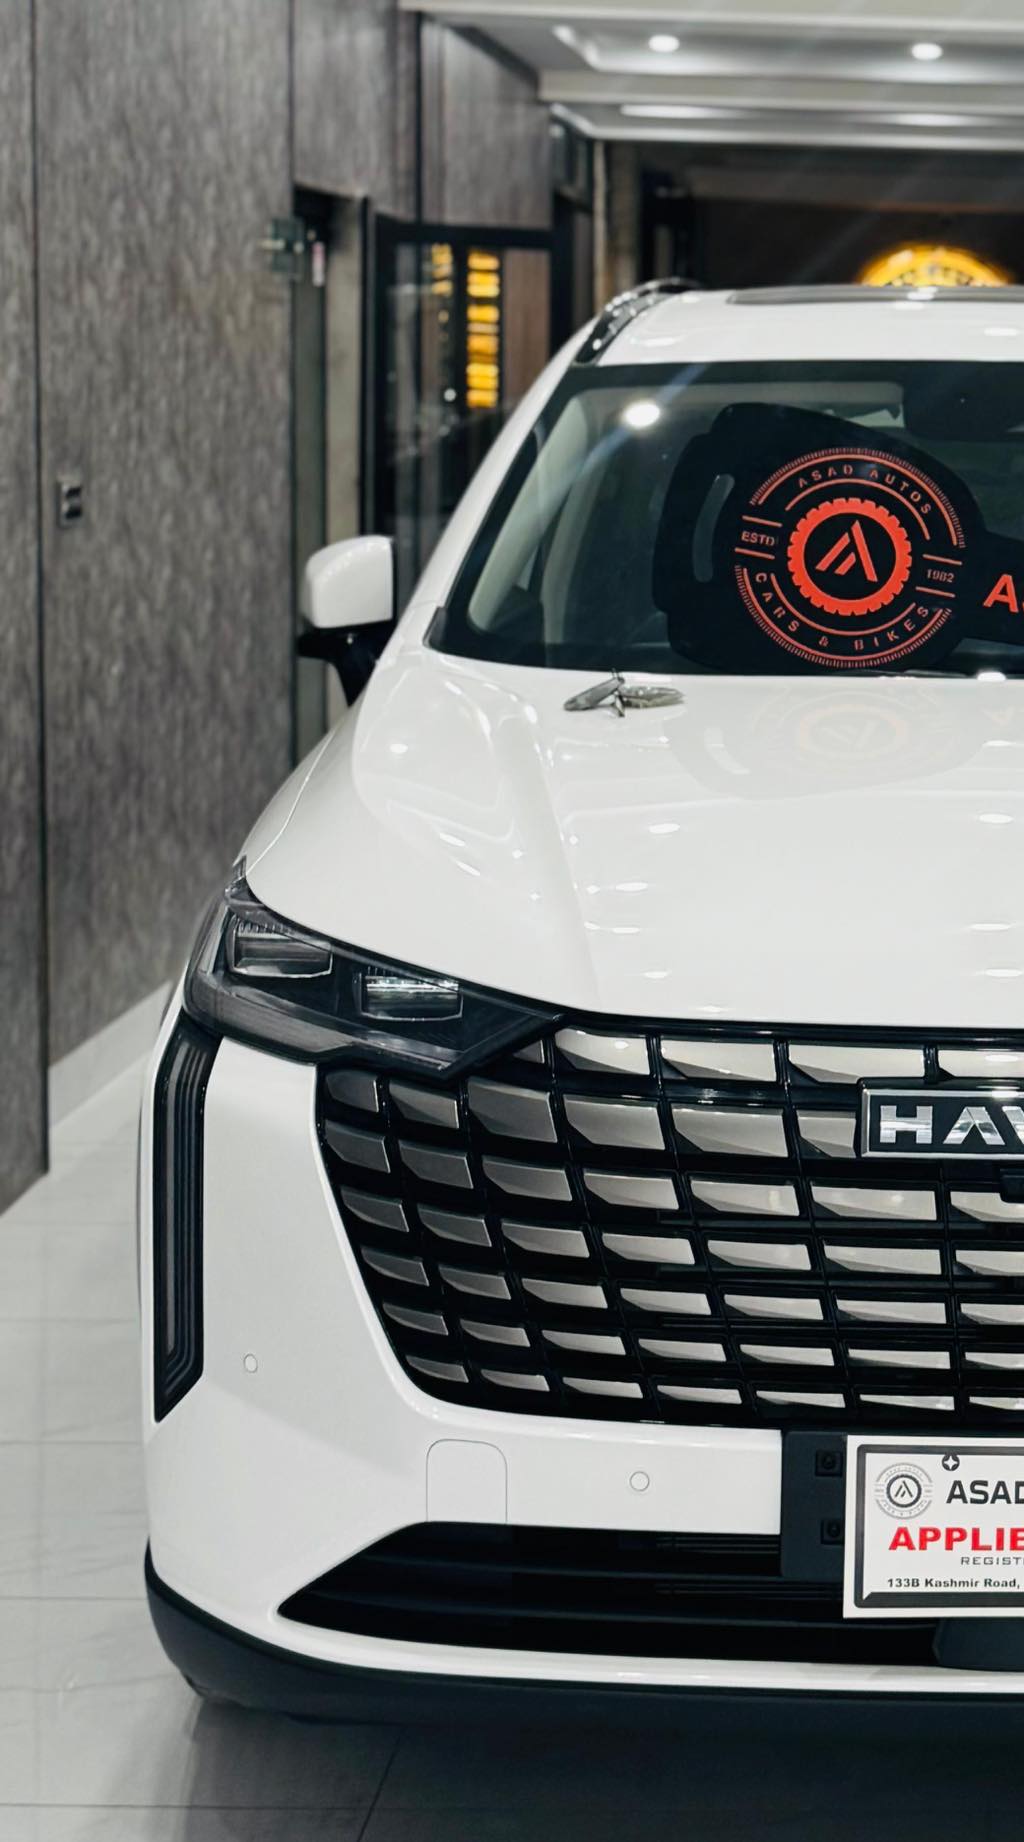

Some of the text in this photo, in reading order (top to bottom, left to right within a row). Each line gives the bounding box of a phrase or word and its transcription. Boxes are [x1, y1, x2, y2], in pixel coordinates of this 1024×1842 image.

[797, 465, 932, 515] ASAD AUTOS
[741, 530, 776, 546] ESTD
[755, 572, 929, 651] CARS & BIKES
[887, 1578, 920, 1588] 133B
[924, 1578, 979, 1588] Kashmir
[984, 1578, 1020, 1590] Road,
